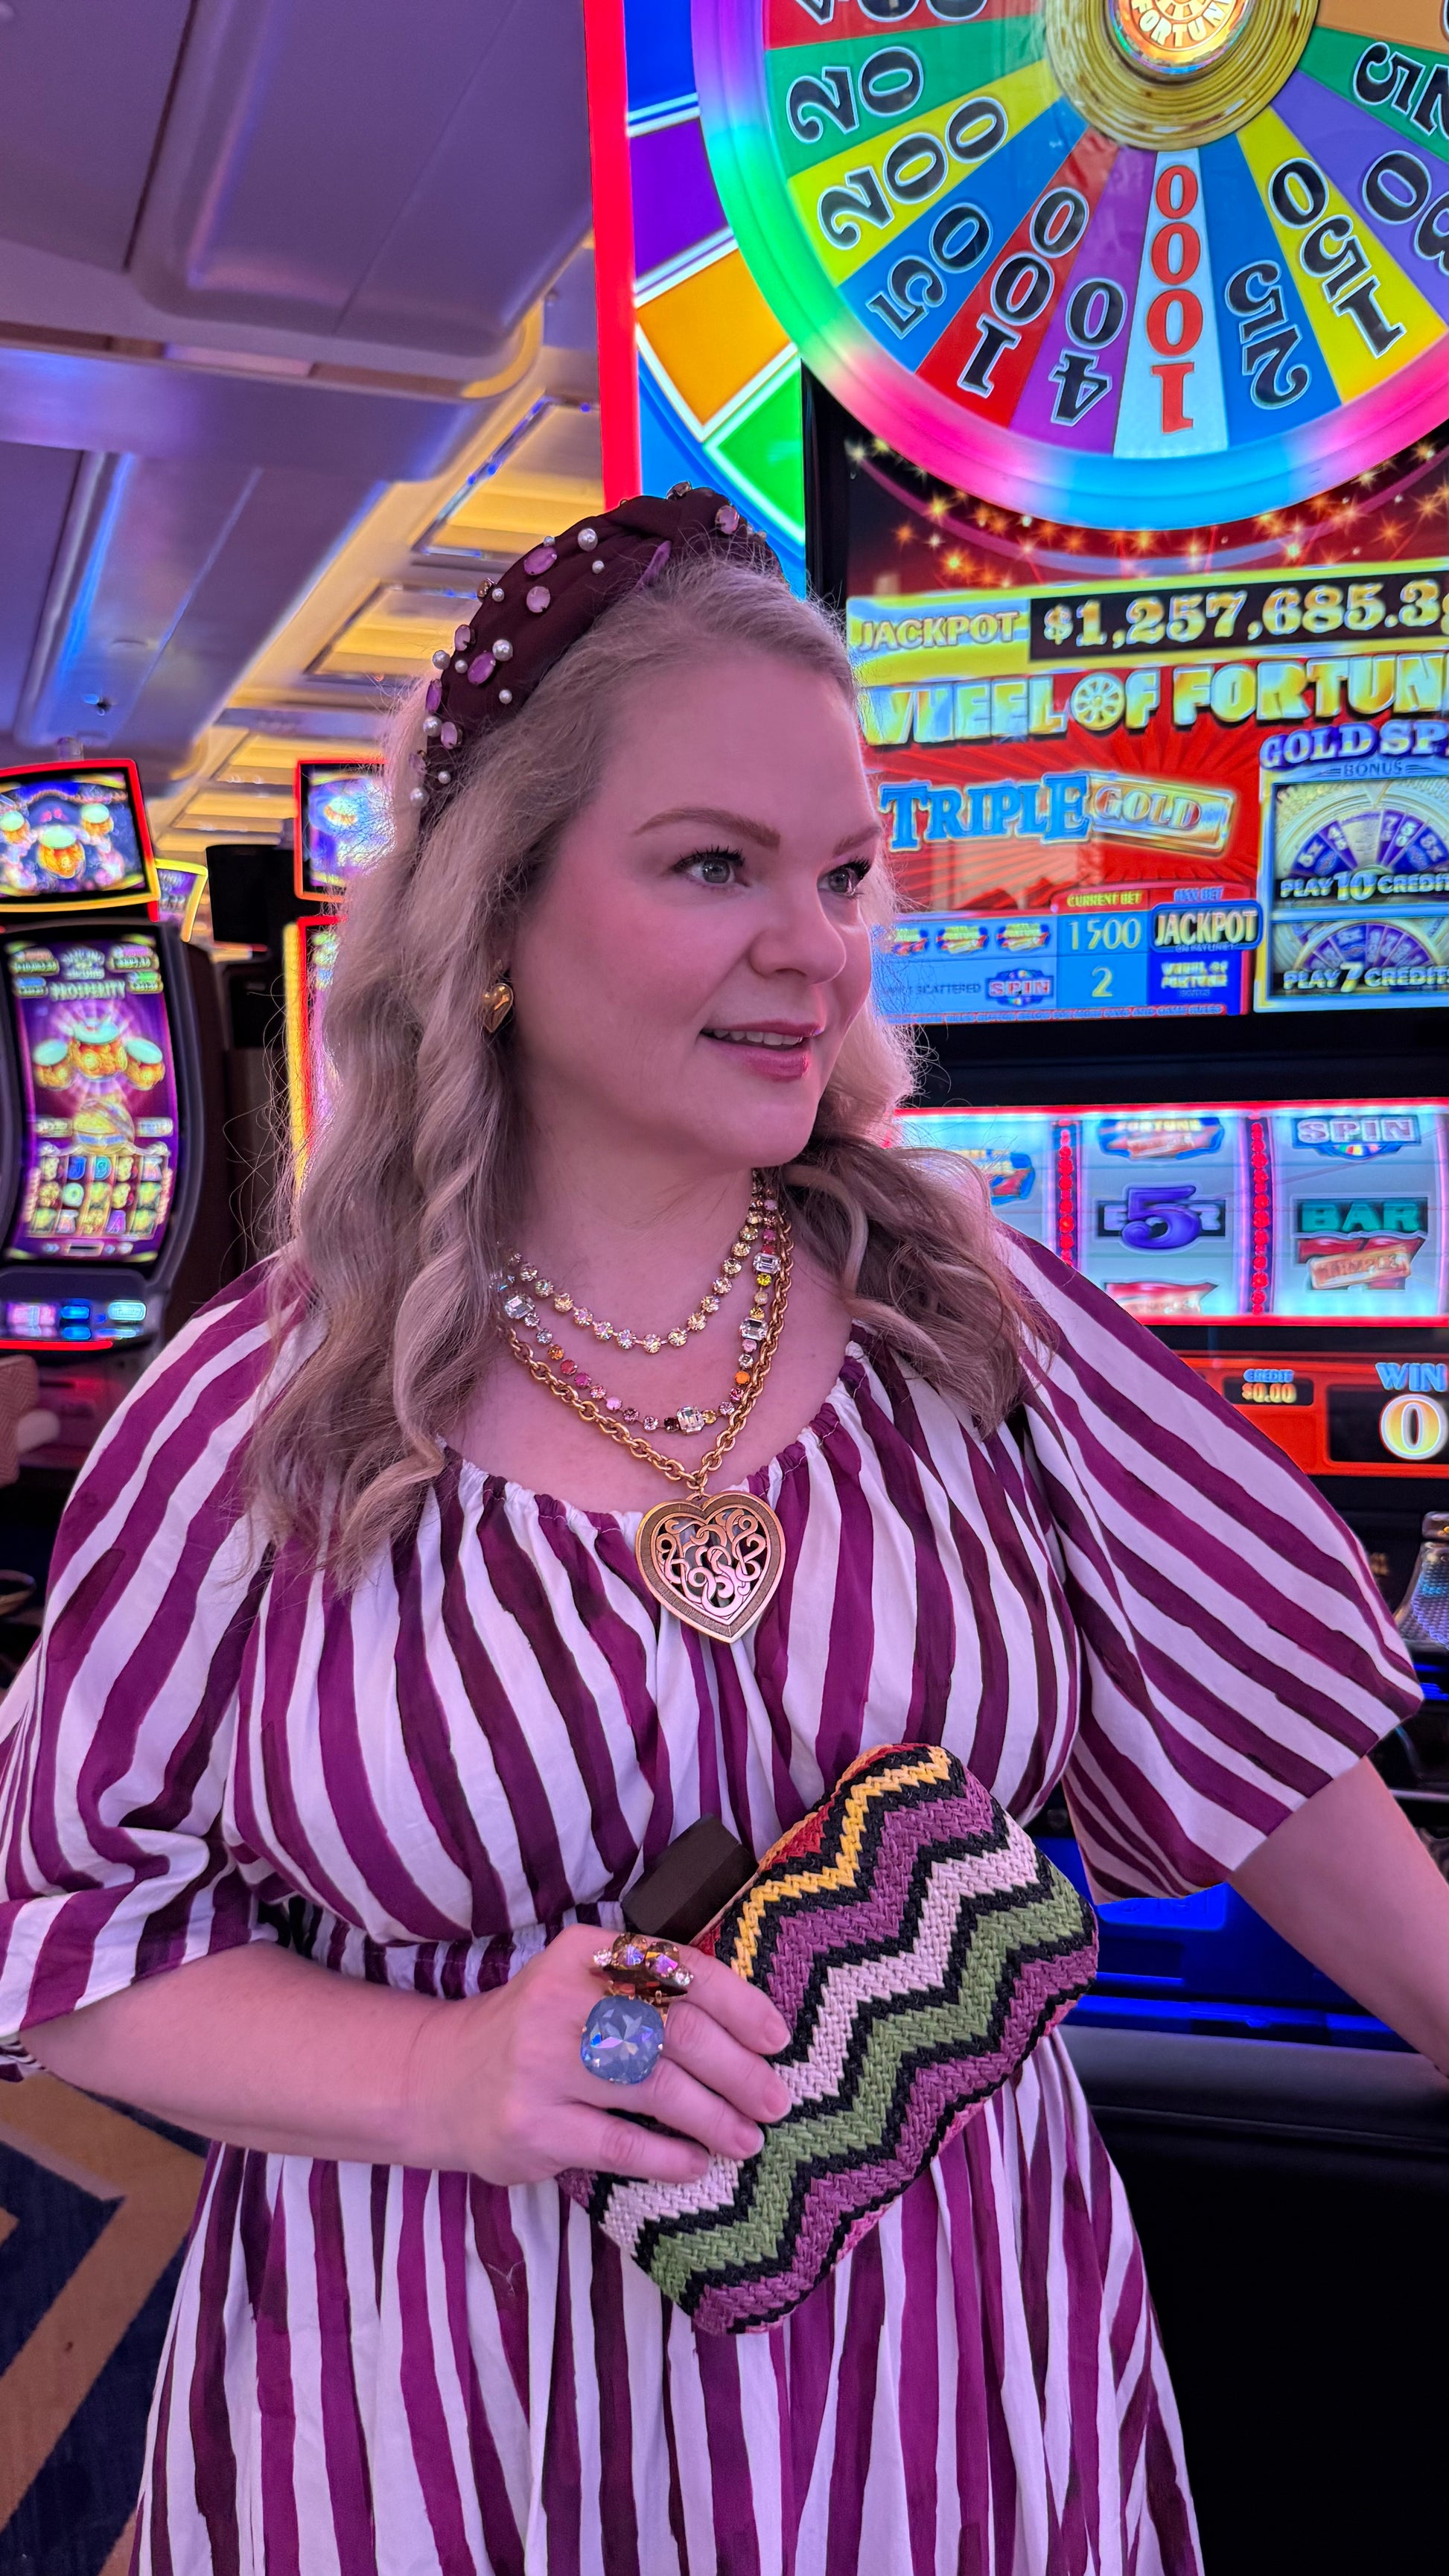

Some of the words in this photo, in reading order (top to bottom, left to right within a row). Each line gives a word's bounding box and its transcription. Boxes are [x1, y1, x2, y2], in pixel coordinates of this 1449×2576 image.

[1131, 0, 1232, 47] FORTUN
[786, 46, 923, 144] 20
[818, 96, 1008, 250] 200
[867, 202, 993, 340] 50
[1267, 157, 1410, 360] 150
[957, 186, 1090, 398] 100
[1144, 163, 1204, 434] 1000
[1048, 278, 1127, 426] 40
[1225, 260, 1312, 409] 25
[859, 610, 1019, 652] JACKPOT
[1043, 578, 1449, 649] $1,257,685.3
[860, 673, 1069, 747] WHEEL
[1173, 650, 1449, 729] FORTUN
[1259, 721, 1378, 770] GOLD
[1379, 718, 1449, 758] SP
[1343, 761, 1403, 777] BONUS
[877, 771, 1092, 852] TRIPLE
[1094, 785, 1202, 831] GOLD
[1067, 892, 1118, 908] CURRENT
[1119, 890, 1144, 905] BET
[1200, 886, 1224, 901] BET
[1280, 877, 1334, 898] PLAY
[1333, 870, 1378, 902] 10
[1069, 918, 1141, 950] 1500
[1154, 908, 1258, 946] JACKPOT
[989, 978, 1051, 997] SPIN
[1092, 966, 1113, 998] 2
[1161, 974, 1228, 989] FORTUNE
[1283, 969, 1340, 989] PLAY
[1340, 961, 1364, 992] 7
[1364, 966, 1449, 987] CREDIT
[1297, 1118, 1414, 1144] SPIN
[1122, 1185, 1202, 1249] 5
[1302, 1201, 1420, 1232] BAR
[1241, 1383, 1297, 1403] $0.00
[1243, 1368, 1295, 1383] CREDIT
[1375, 1362, 1448, 1392] WIN
[1379, 1394, 1449, 1460] 0
